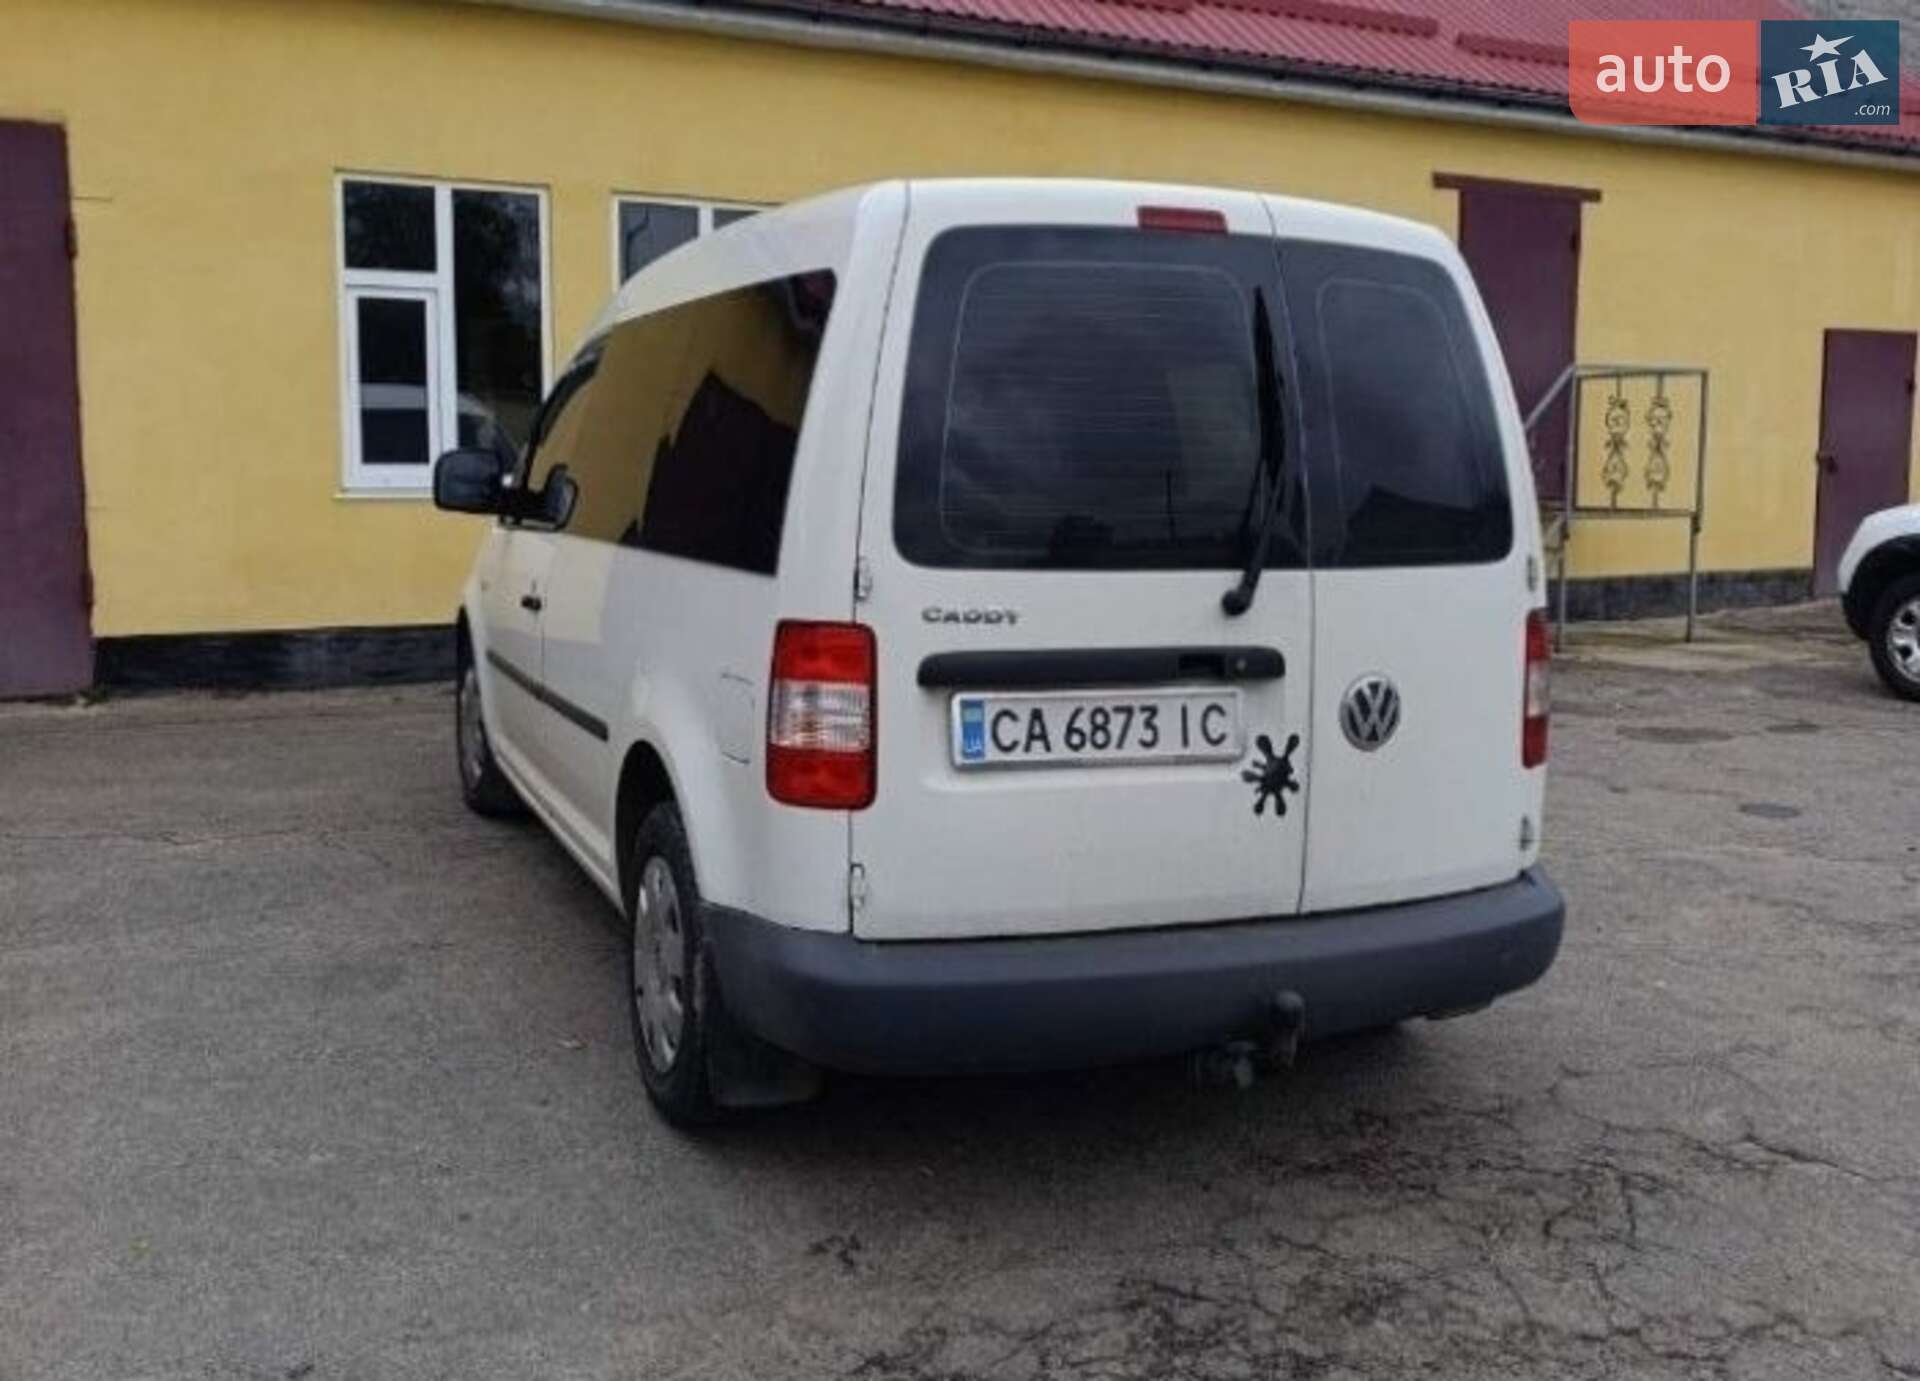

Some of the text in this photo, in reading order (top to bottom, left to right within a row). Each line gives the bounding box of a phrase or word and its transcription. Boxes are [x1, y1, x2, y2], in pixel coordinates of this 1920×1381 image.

[921, 606, 1018, 626] CADDY
[991, 709, 1052, 754] CA
[1064, 705, 1160, 751] 6873
